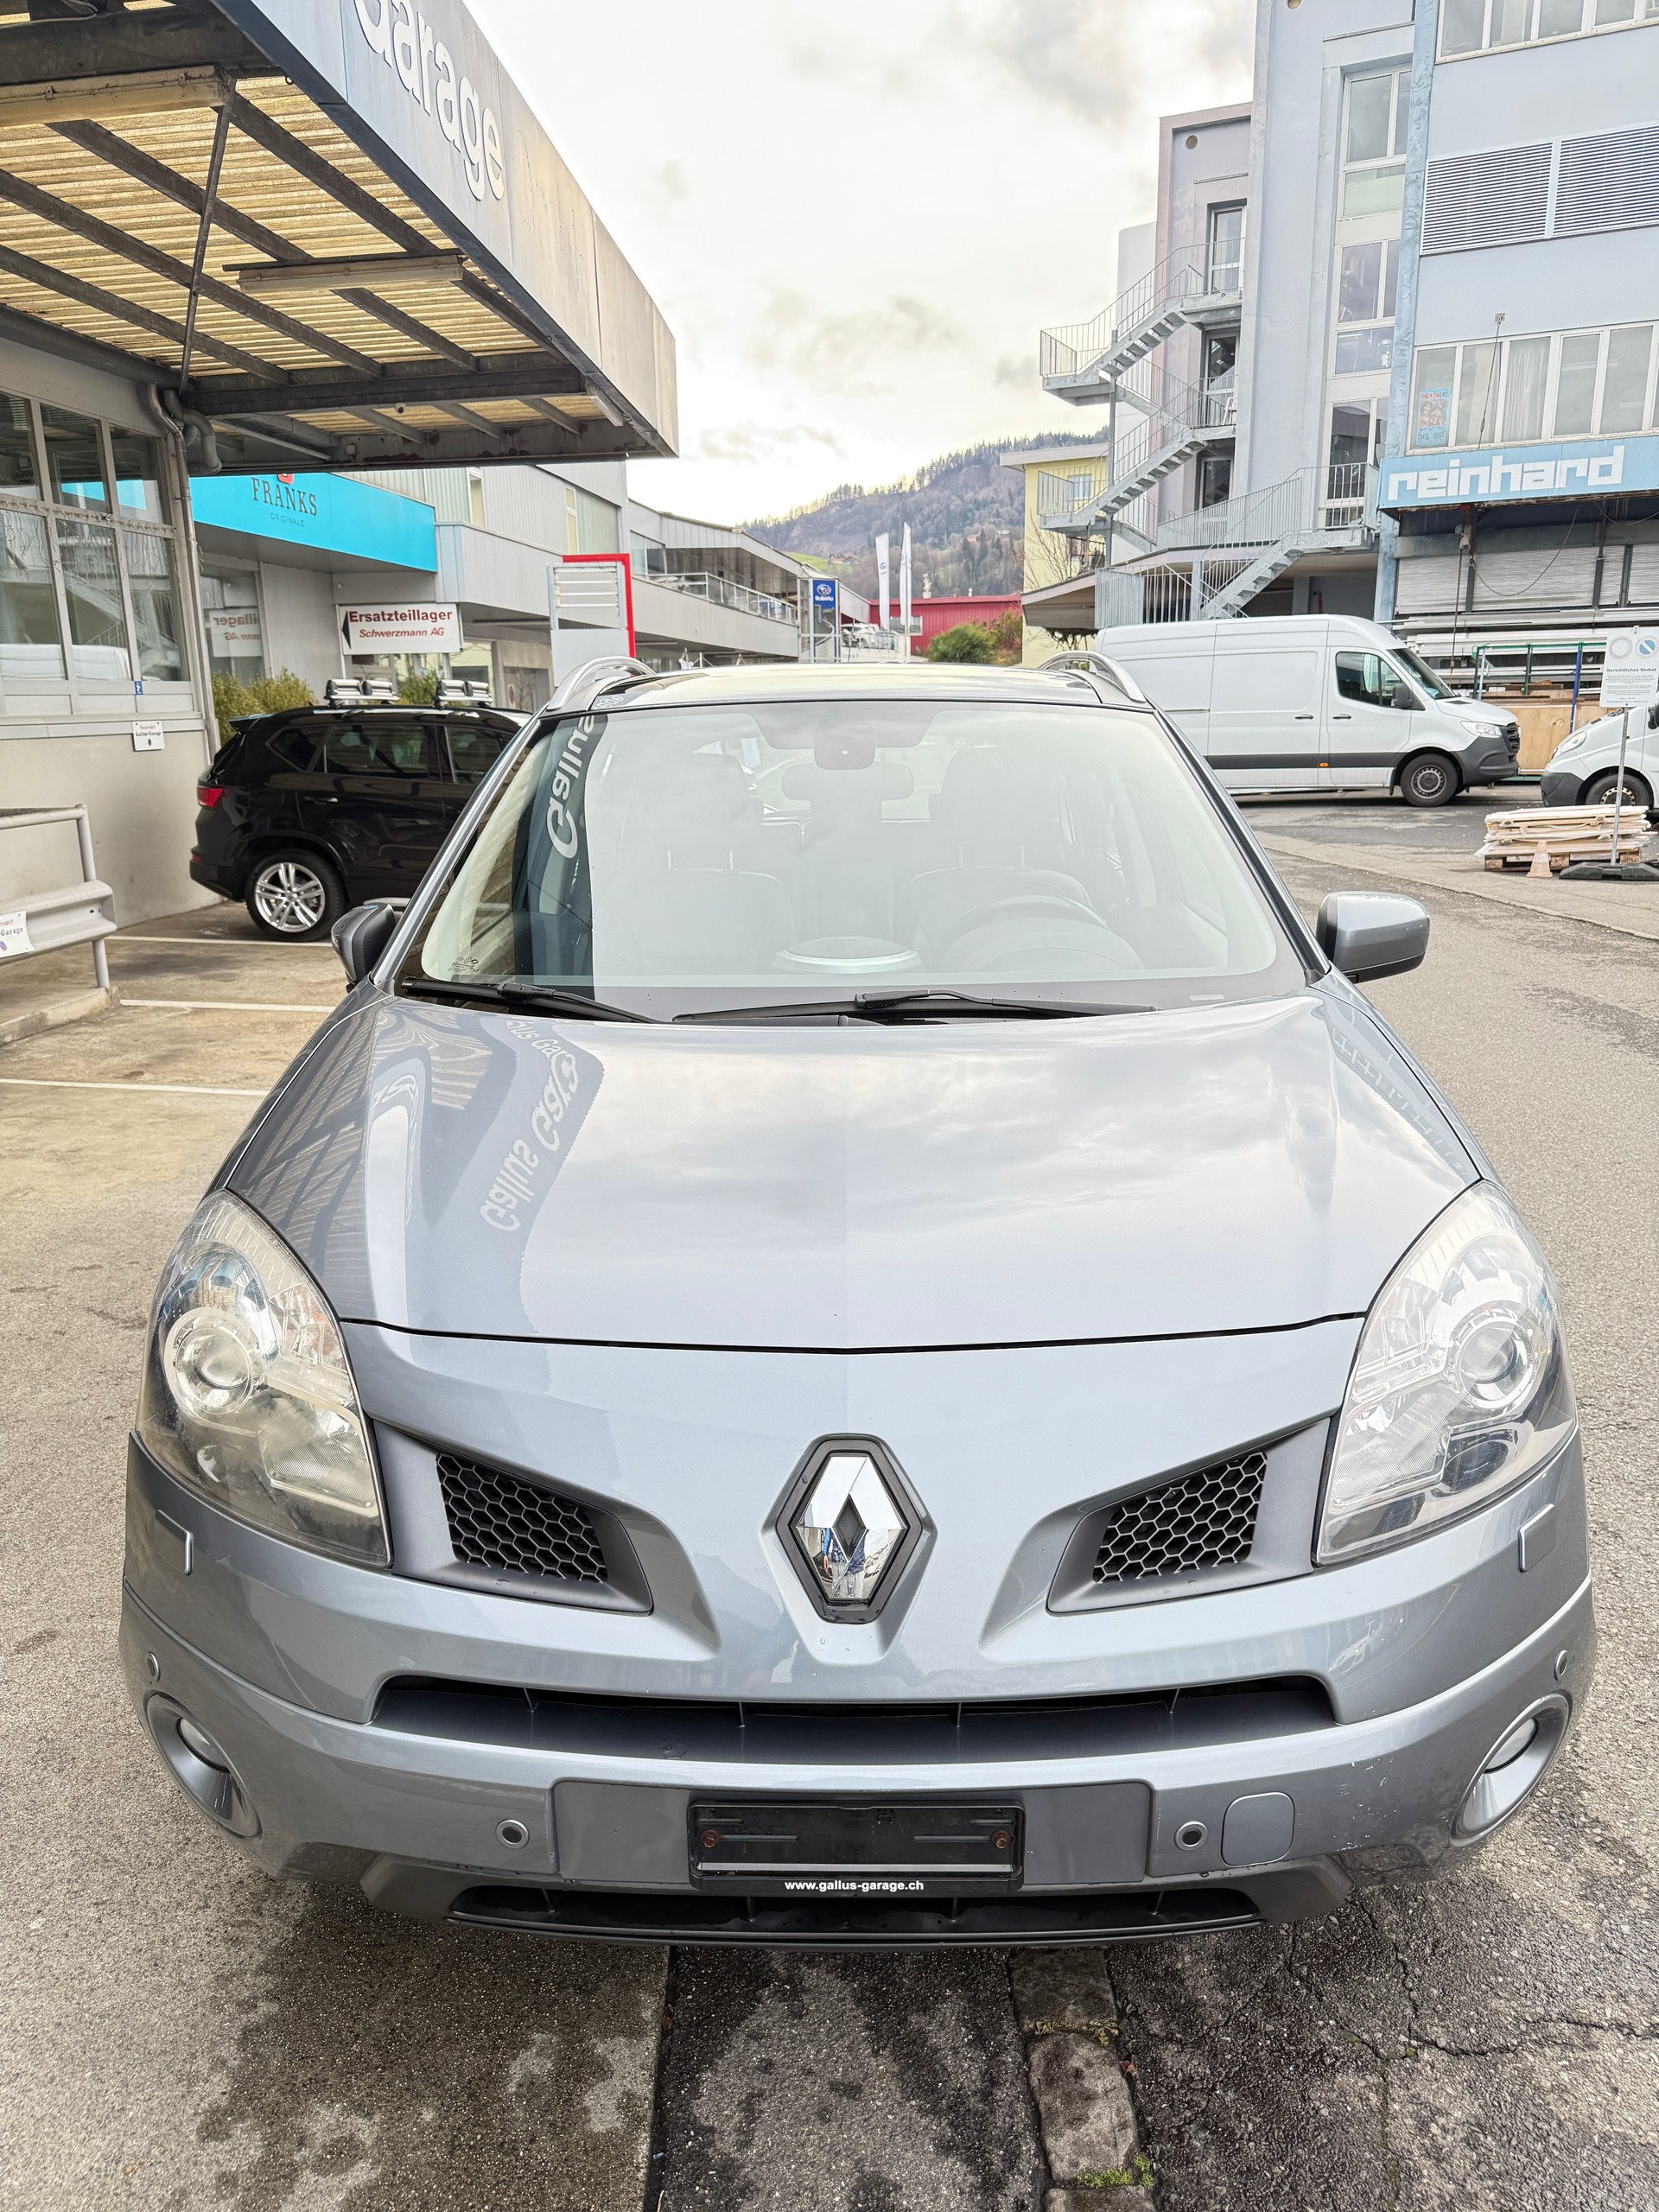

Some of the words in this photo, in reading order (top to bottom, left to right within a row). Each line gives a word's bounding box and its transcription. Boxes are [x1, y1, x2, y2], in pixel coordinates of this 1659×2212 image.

[1388, 445, 1624, 500] reinhard
[251, 477, 317, 517] FRANKS
[349, 609, 452, 622] Ersatzteillager
[359, 629, 428, 638] Schwerzmann
[430, 627, 445, 636] AG
[785, 1879, 924, 1892] www.gallus-garage.ch
